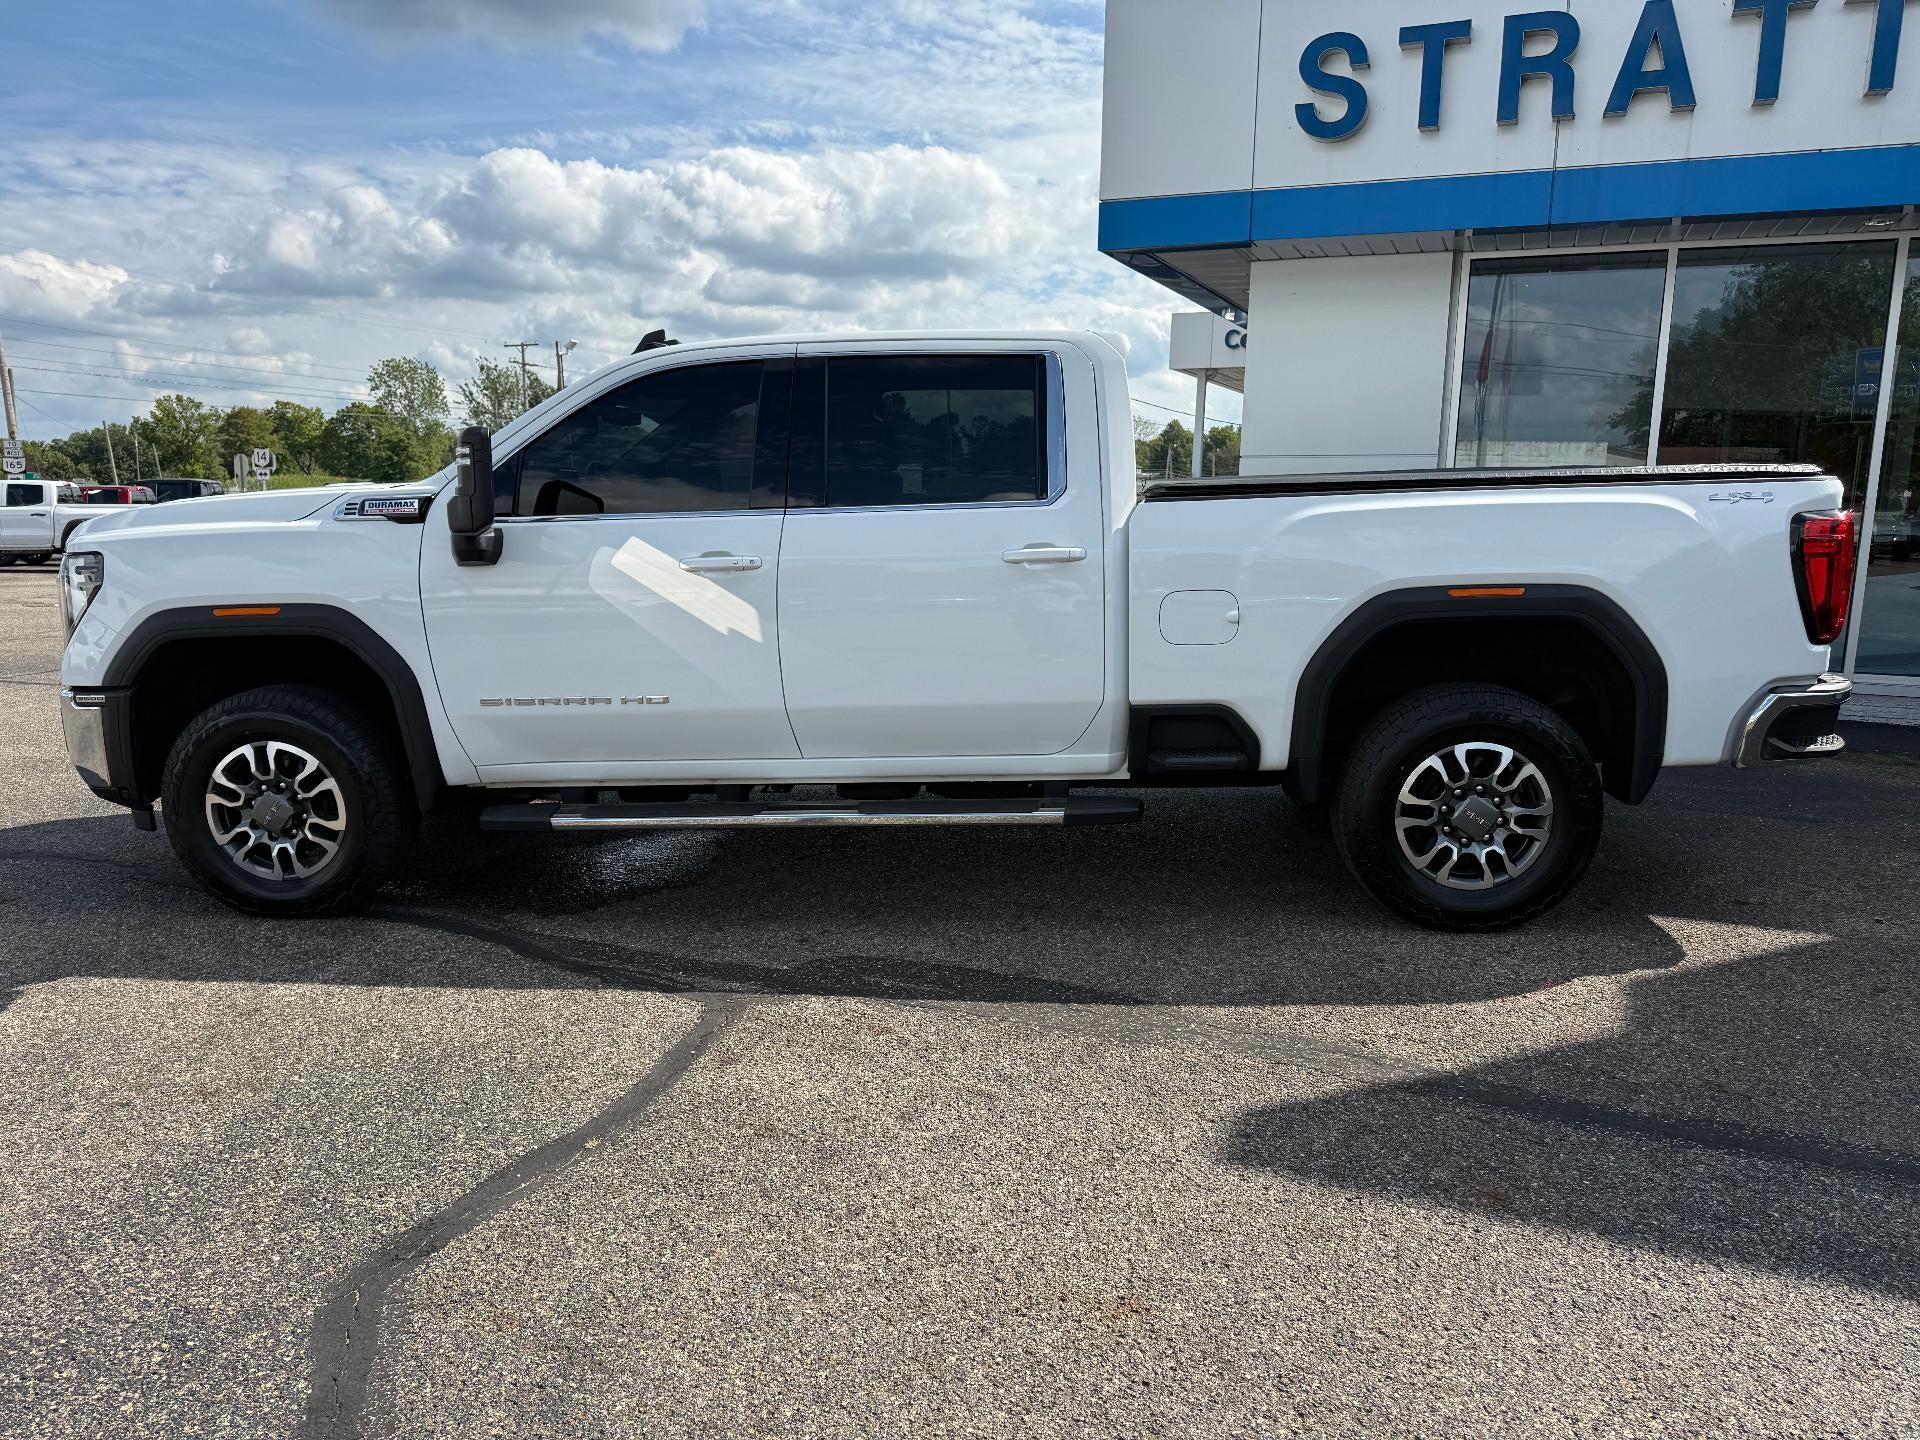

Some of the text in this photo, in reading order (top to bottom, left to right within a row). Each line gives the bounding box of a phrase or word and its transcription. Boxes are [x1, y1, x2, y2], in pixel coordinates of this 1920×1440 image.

[257, 451, 267, 462] 14
[5, 461, 23, 469] 165
[368, 501, 416, 509] DURAMAX
[480, 695, 670, 706] SIERRA HD
